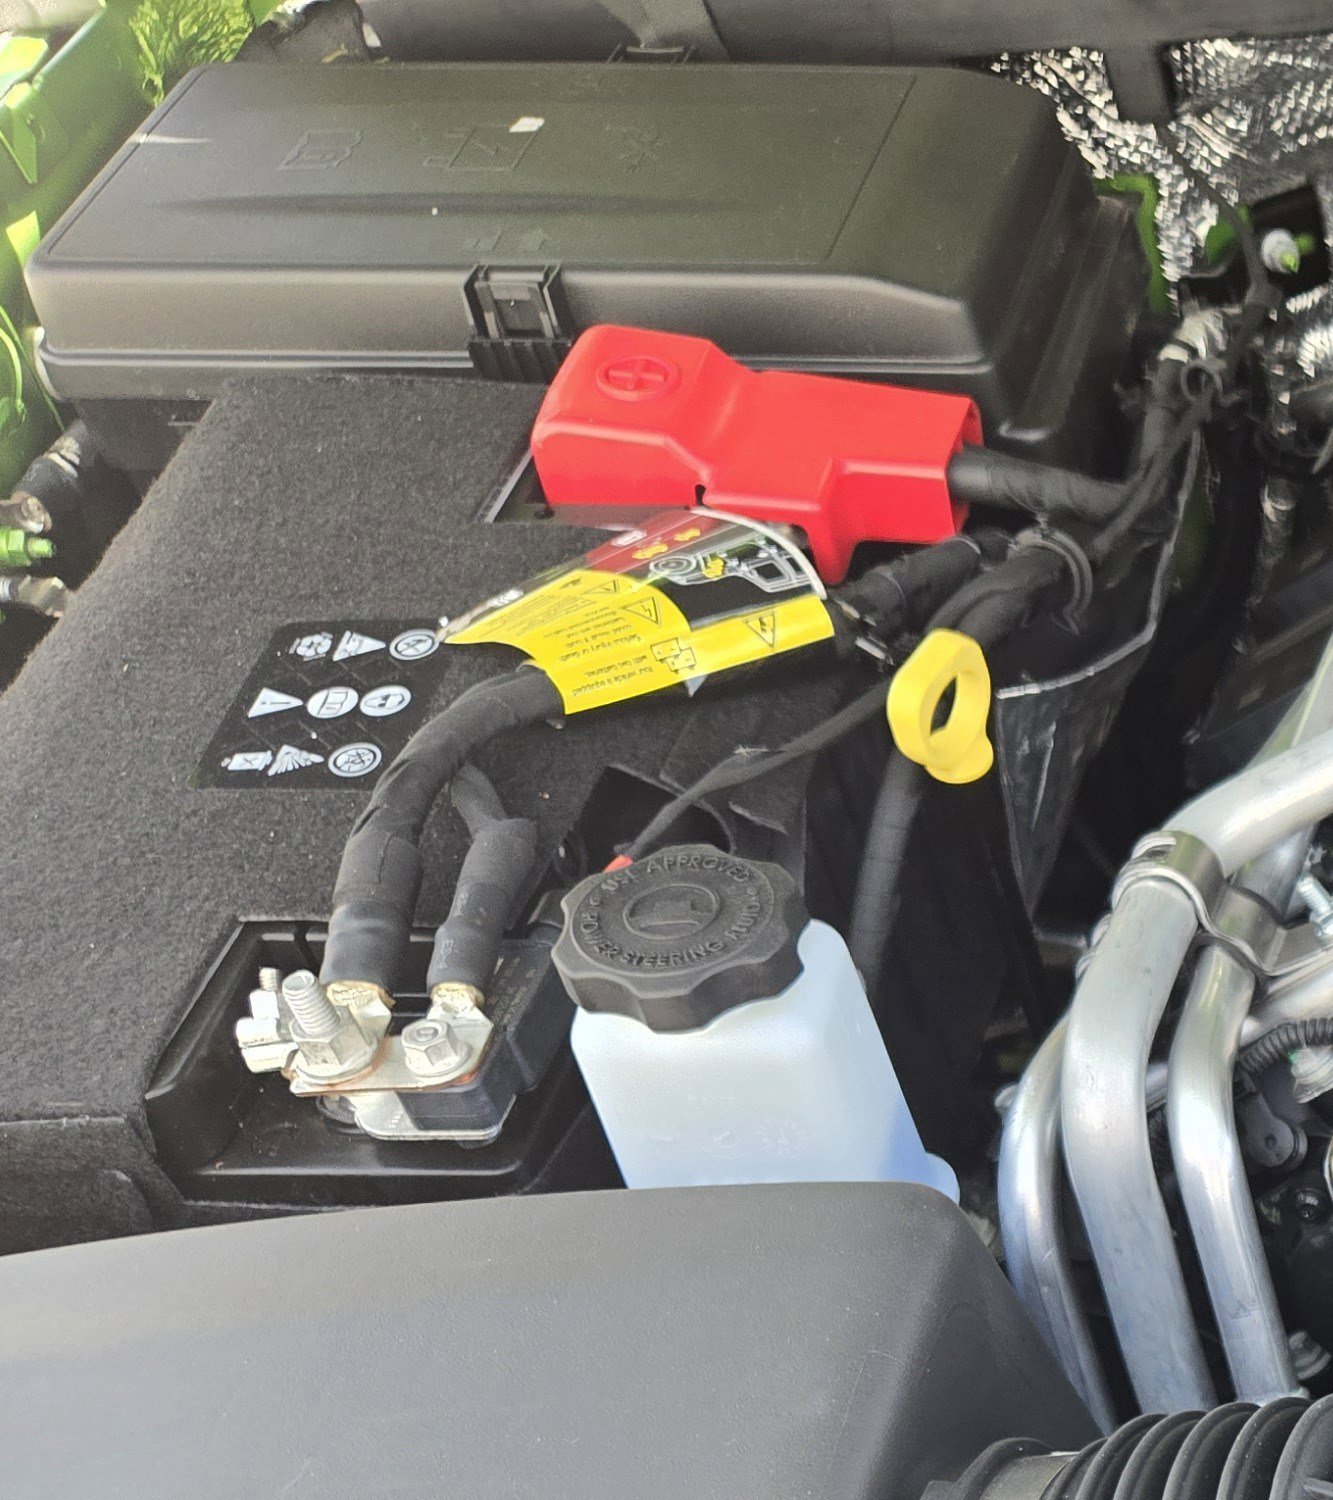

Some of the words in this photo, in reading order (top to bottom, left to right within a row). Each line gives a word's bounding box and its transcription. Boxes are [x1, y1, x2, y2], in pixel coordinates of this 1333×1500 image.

[601, 869, 639, 892] USE
[646, 855, 750, 882] APPROVED
[580, 911, 621, 959] POWER
[620, 940, 724, 968] STEERING
